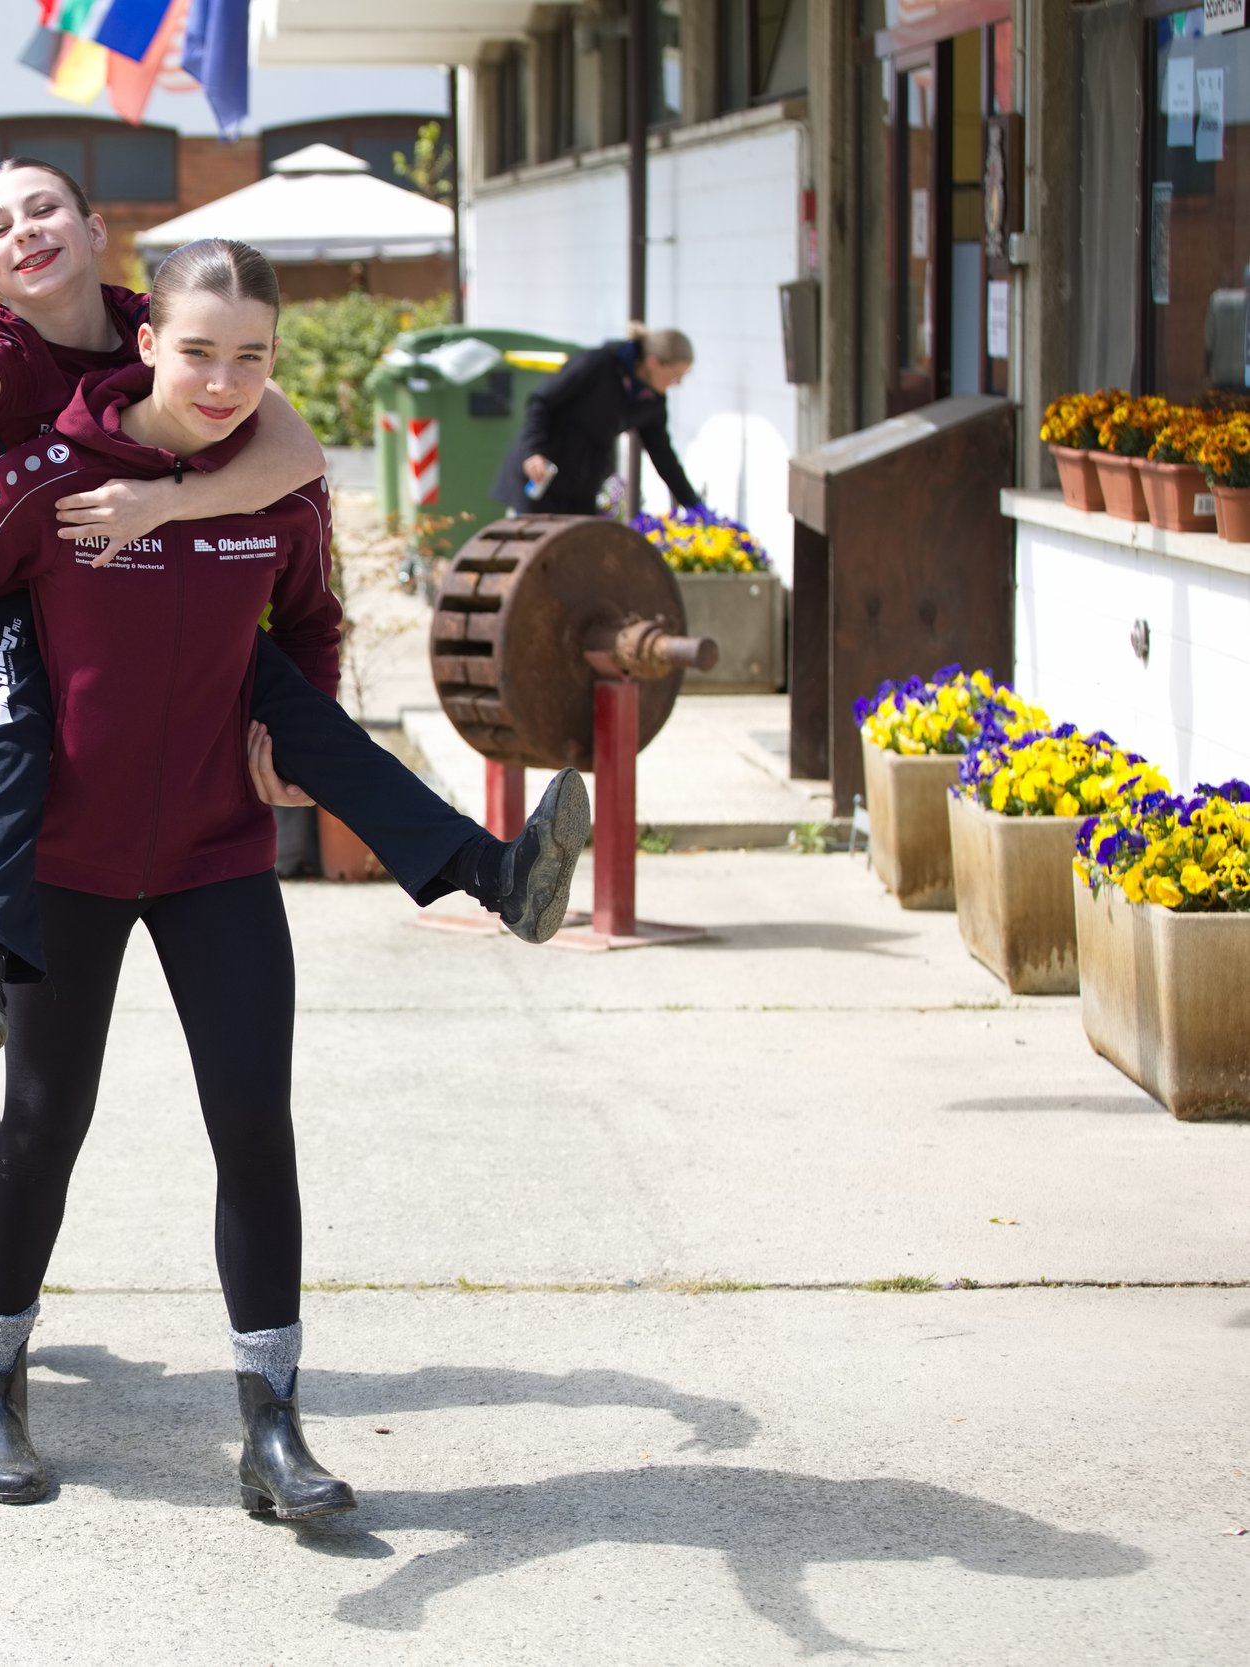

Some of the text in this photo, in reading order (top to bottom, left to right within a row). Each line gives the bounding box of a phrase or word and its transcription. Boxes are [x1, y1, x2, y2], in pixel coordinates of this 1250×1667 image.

[75, 536, 162, 552] RAIFISEN
[218, 536, 277, 551] Oberhänsli
[12, 618, 22, 632] AG
